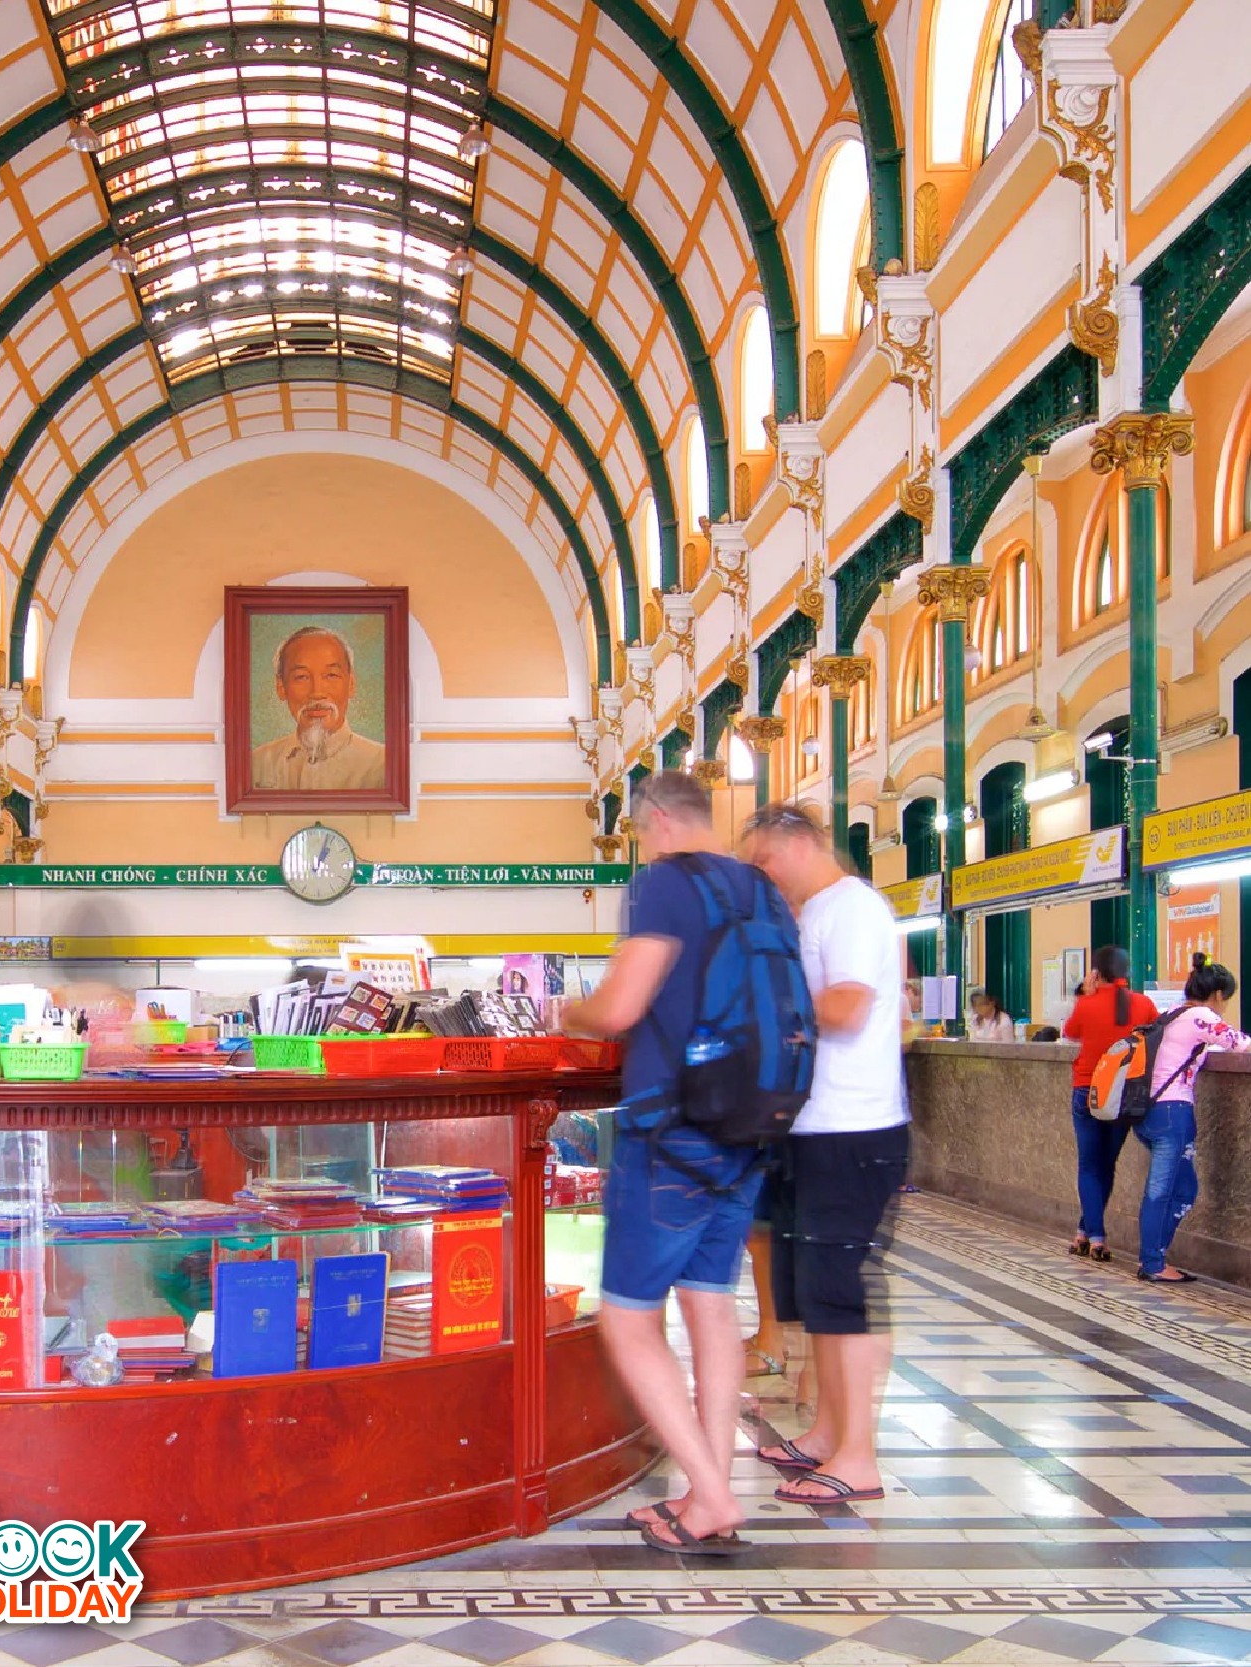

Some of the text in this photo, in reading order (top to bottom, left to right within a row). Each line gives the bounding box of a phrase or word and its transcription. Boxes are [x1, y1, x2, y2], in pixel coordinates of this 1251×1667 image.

[41, 869, 96, 883] NHANH
[101, 865, 156, 883] CHÓNG
[175, 865, 228, 883] CHÍNH
[235, 865, 268, 883] XÁC
[444, 865, 481, 884] TIỆN
[484, 866, 509, 884] LỢI
[520, 865, 552, 882] VĂN
[555, 868, 595, 882] MINH
